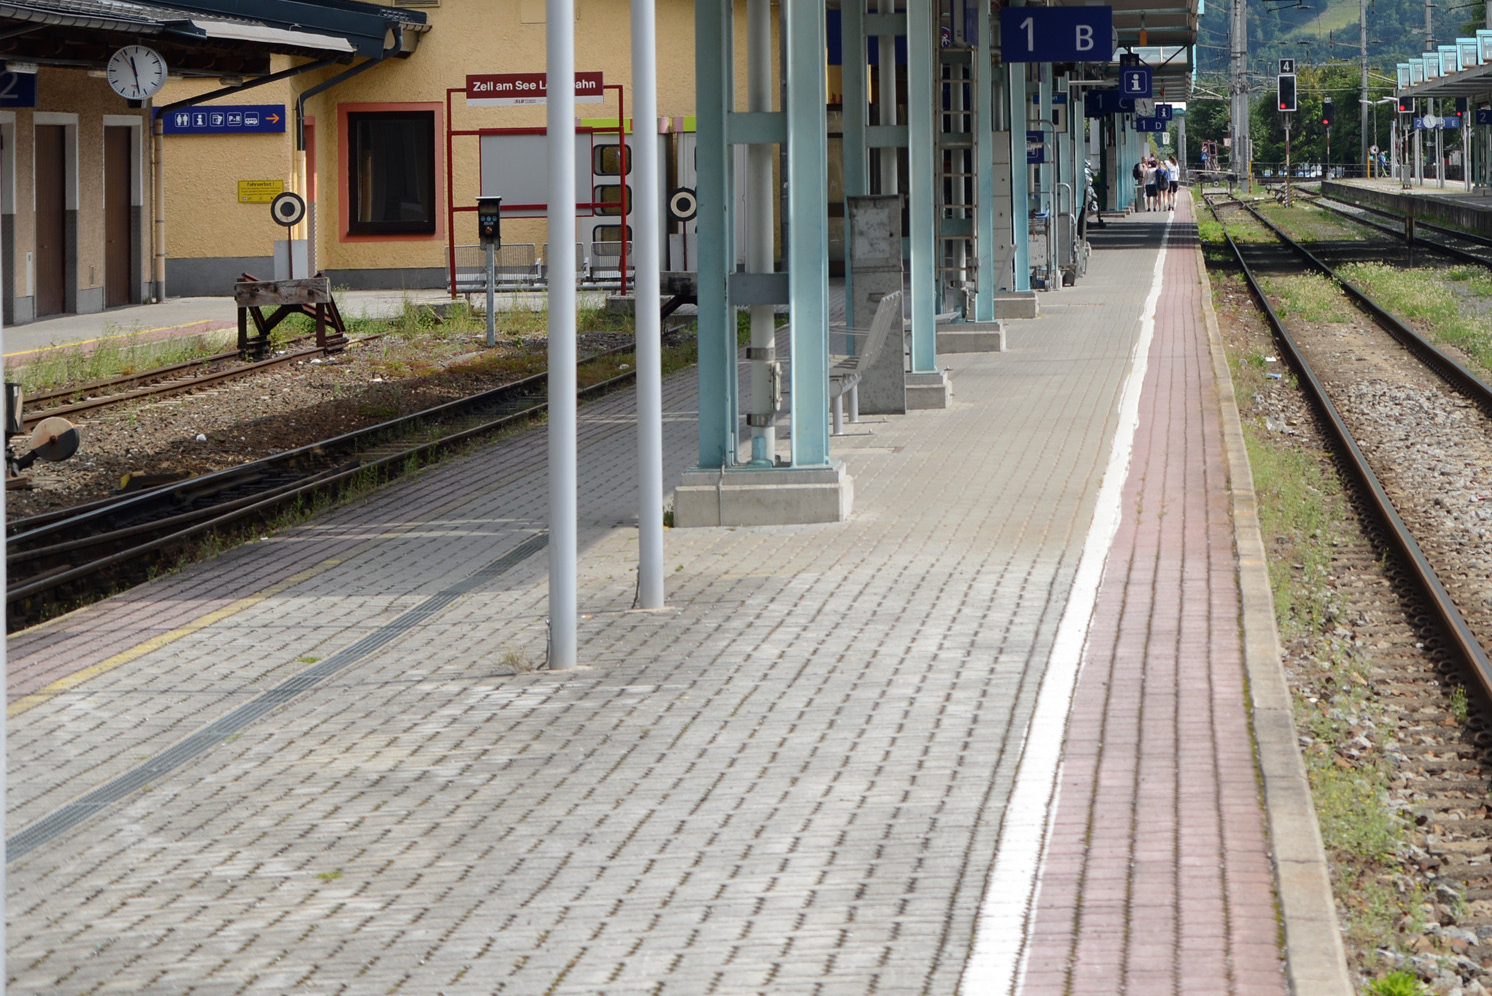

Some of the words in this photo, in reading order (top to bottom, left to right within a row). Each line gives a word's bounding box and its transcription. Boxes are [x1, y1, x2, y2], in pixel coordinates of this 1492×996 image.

[1019, 16, 1034, 52] 1
[1075, 24, 1094, 51] B
[1283, 61, 1290, 72] 4
[473, 81, 493, 92] Zell
[496, 83, 513, 91] am
[515, 80, 536, 91] See
[1096, 94, 1103, 109] 1
[1118, 98, 1128, 109] C
[1480, 112, 1486, 122] 2
[1141, 121, 1146, 130] 1
[1155, 122, 1162, 130] D
[1416, 119, 1422, 128] 2
